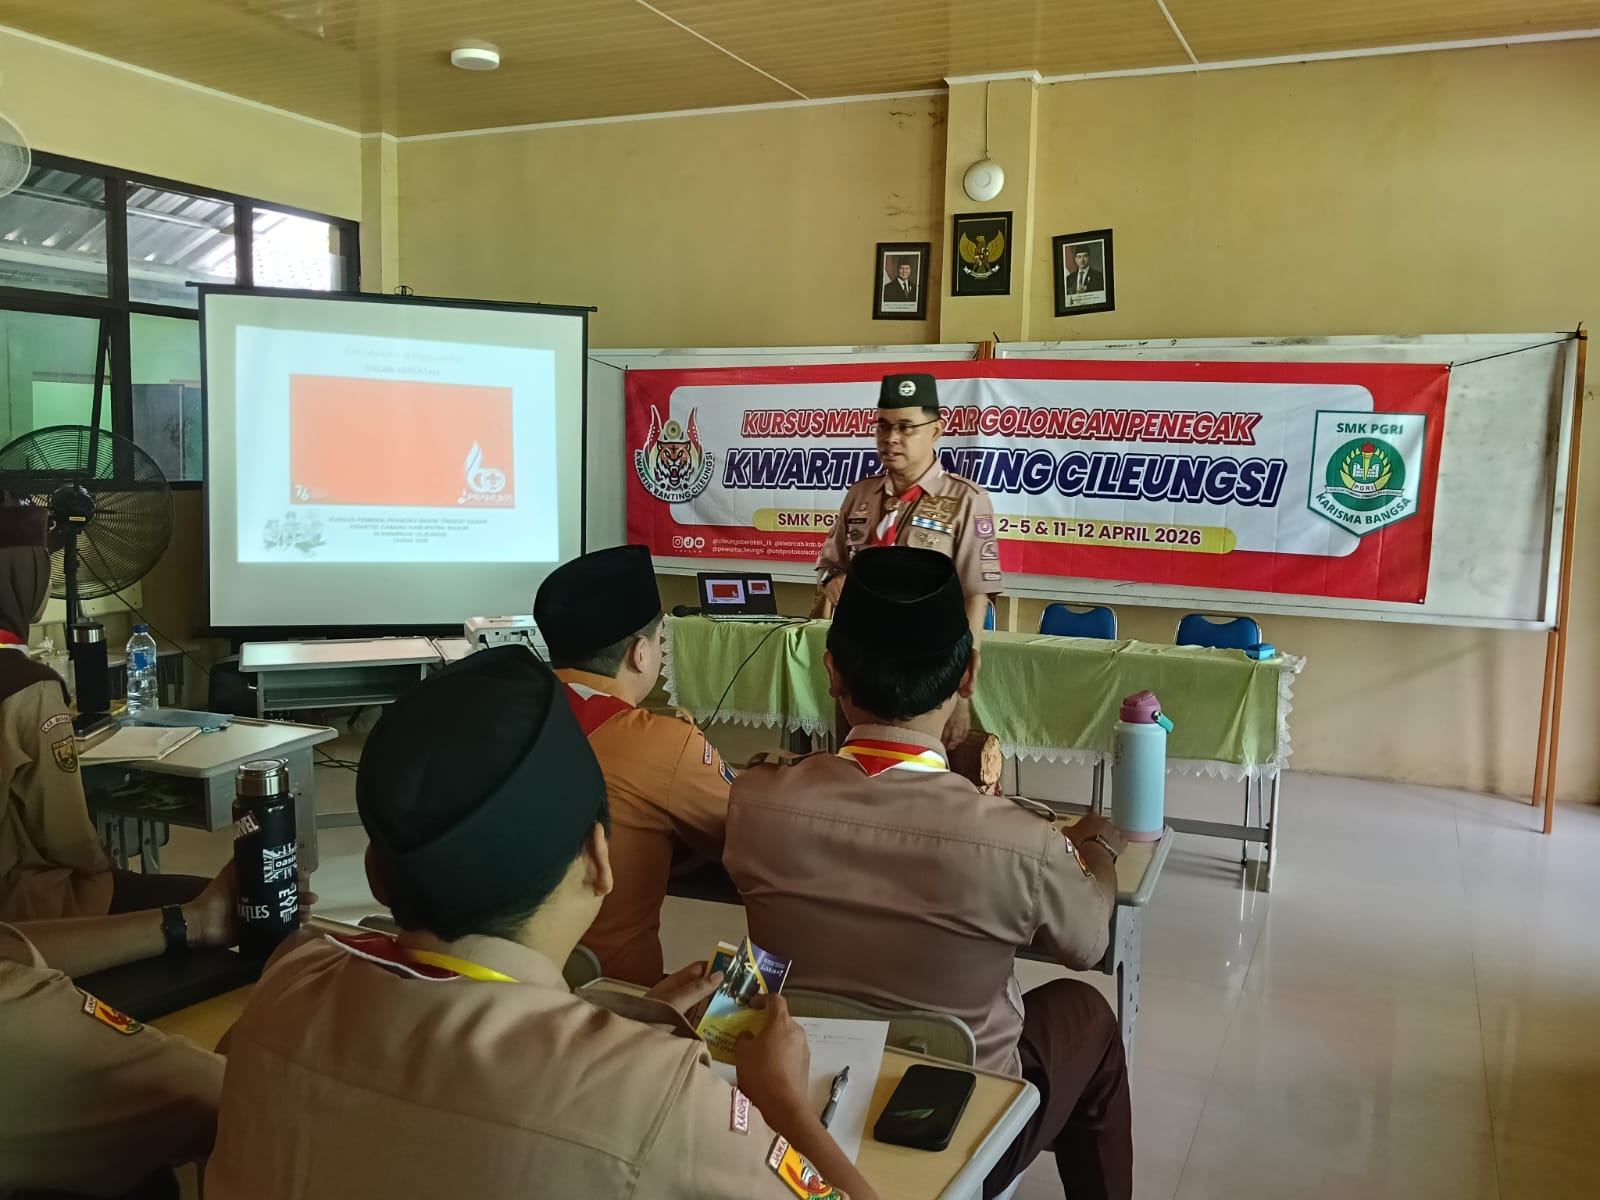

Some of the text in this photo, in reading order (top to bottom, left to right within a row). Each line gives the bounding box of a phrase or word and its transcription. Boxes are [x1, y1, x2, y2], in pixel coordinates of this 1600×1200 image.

[741, 409, 826, 438] KURSUS
[824, 409, 879, 438] MAH
[979, 406, 1128, 443] GOLONGAN
[1125, 409, 1262, 446] PENEGAK
[1336, 423, 1404, 435] SMK PGRI
[636, 451, 713, 501] KWARTIR RANTING CILEUNGSI
[1055, 450, 1288, 507] CILEUNGSI
[1316, 493, 1411, 525] KARISMA BANGSA
[777, 513, 811, 527] SMK
[813, 514, 838, 527] PG
[1034, 521, 1048, 535] &
[1098, 525, 1150, 542] APRIL
[1154, 527, 1201, 545] 2026
